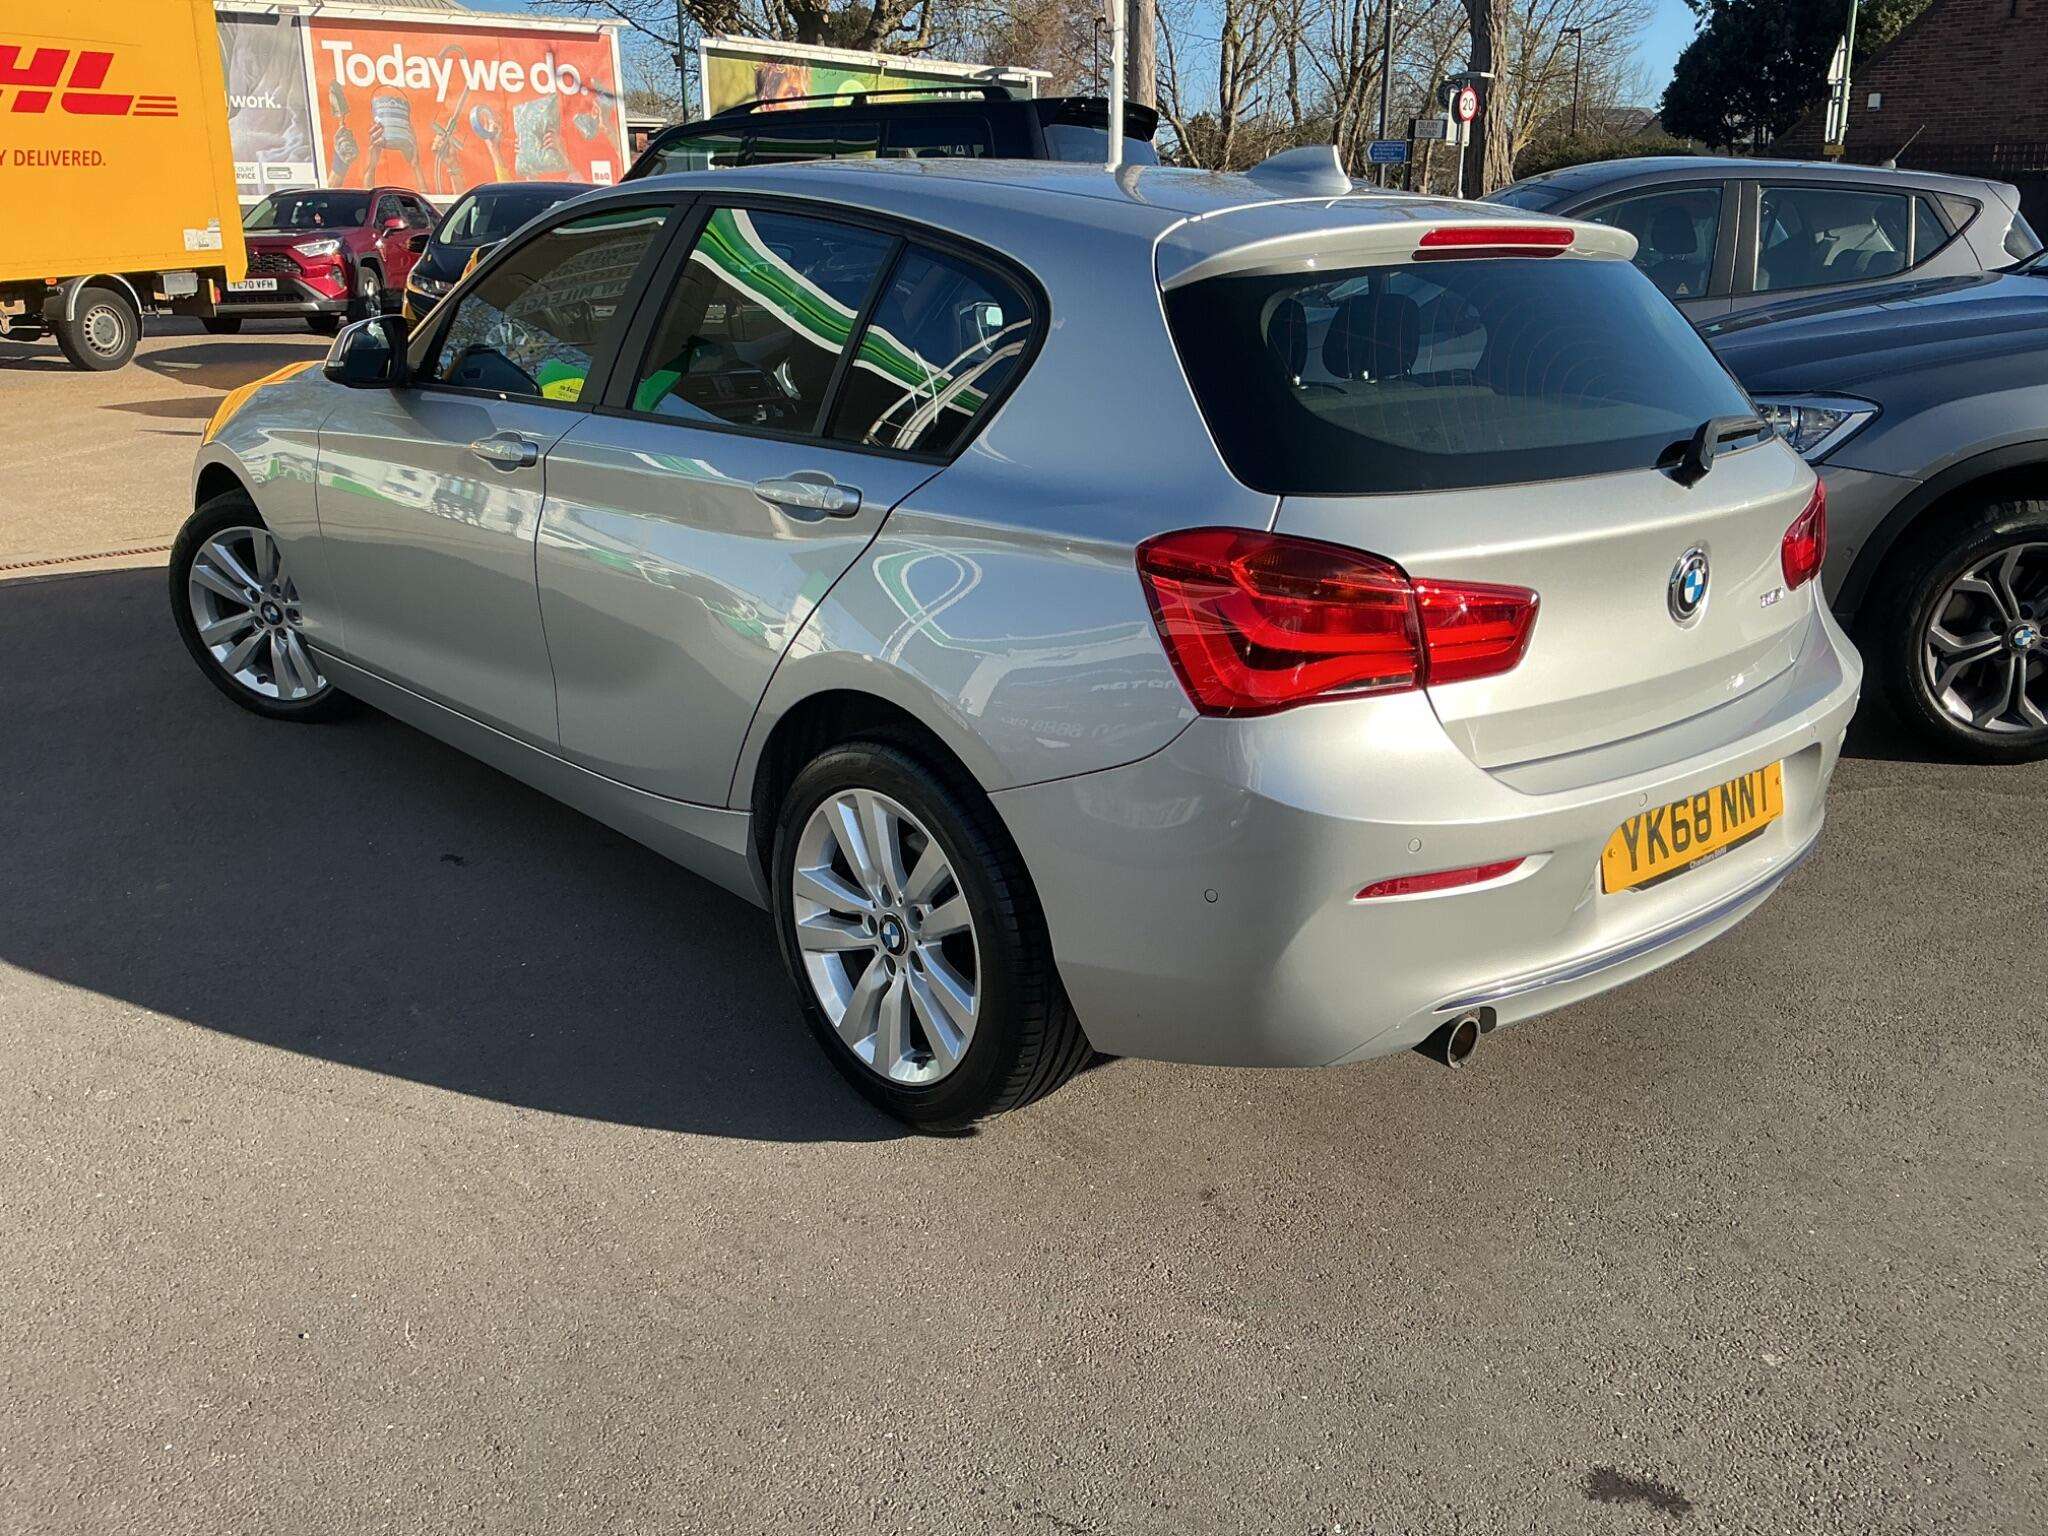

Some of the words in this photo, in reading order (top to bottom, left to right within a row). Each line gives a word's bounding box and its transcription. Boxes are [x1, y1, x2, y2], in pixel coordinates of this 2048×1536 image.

[0, 44, 135, 116] HL
[321, 39, 454, 103] Today
[459, 57, 525, 93] we
[529, 51, 589, 96] do.
[229, 91, 282, 109] work.
[1462, 97, 1475, 112] 20
[13, 149, 107, 167] DELIVERED.
[236, 172, 256, 180] RVICE
[255, 279, 273, 289] VFH
[1620, 788, 1713, 873] YK68
[1719, 768, 1768, 833] NNT
